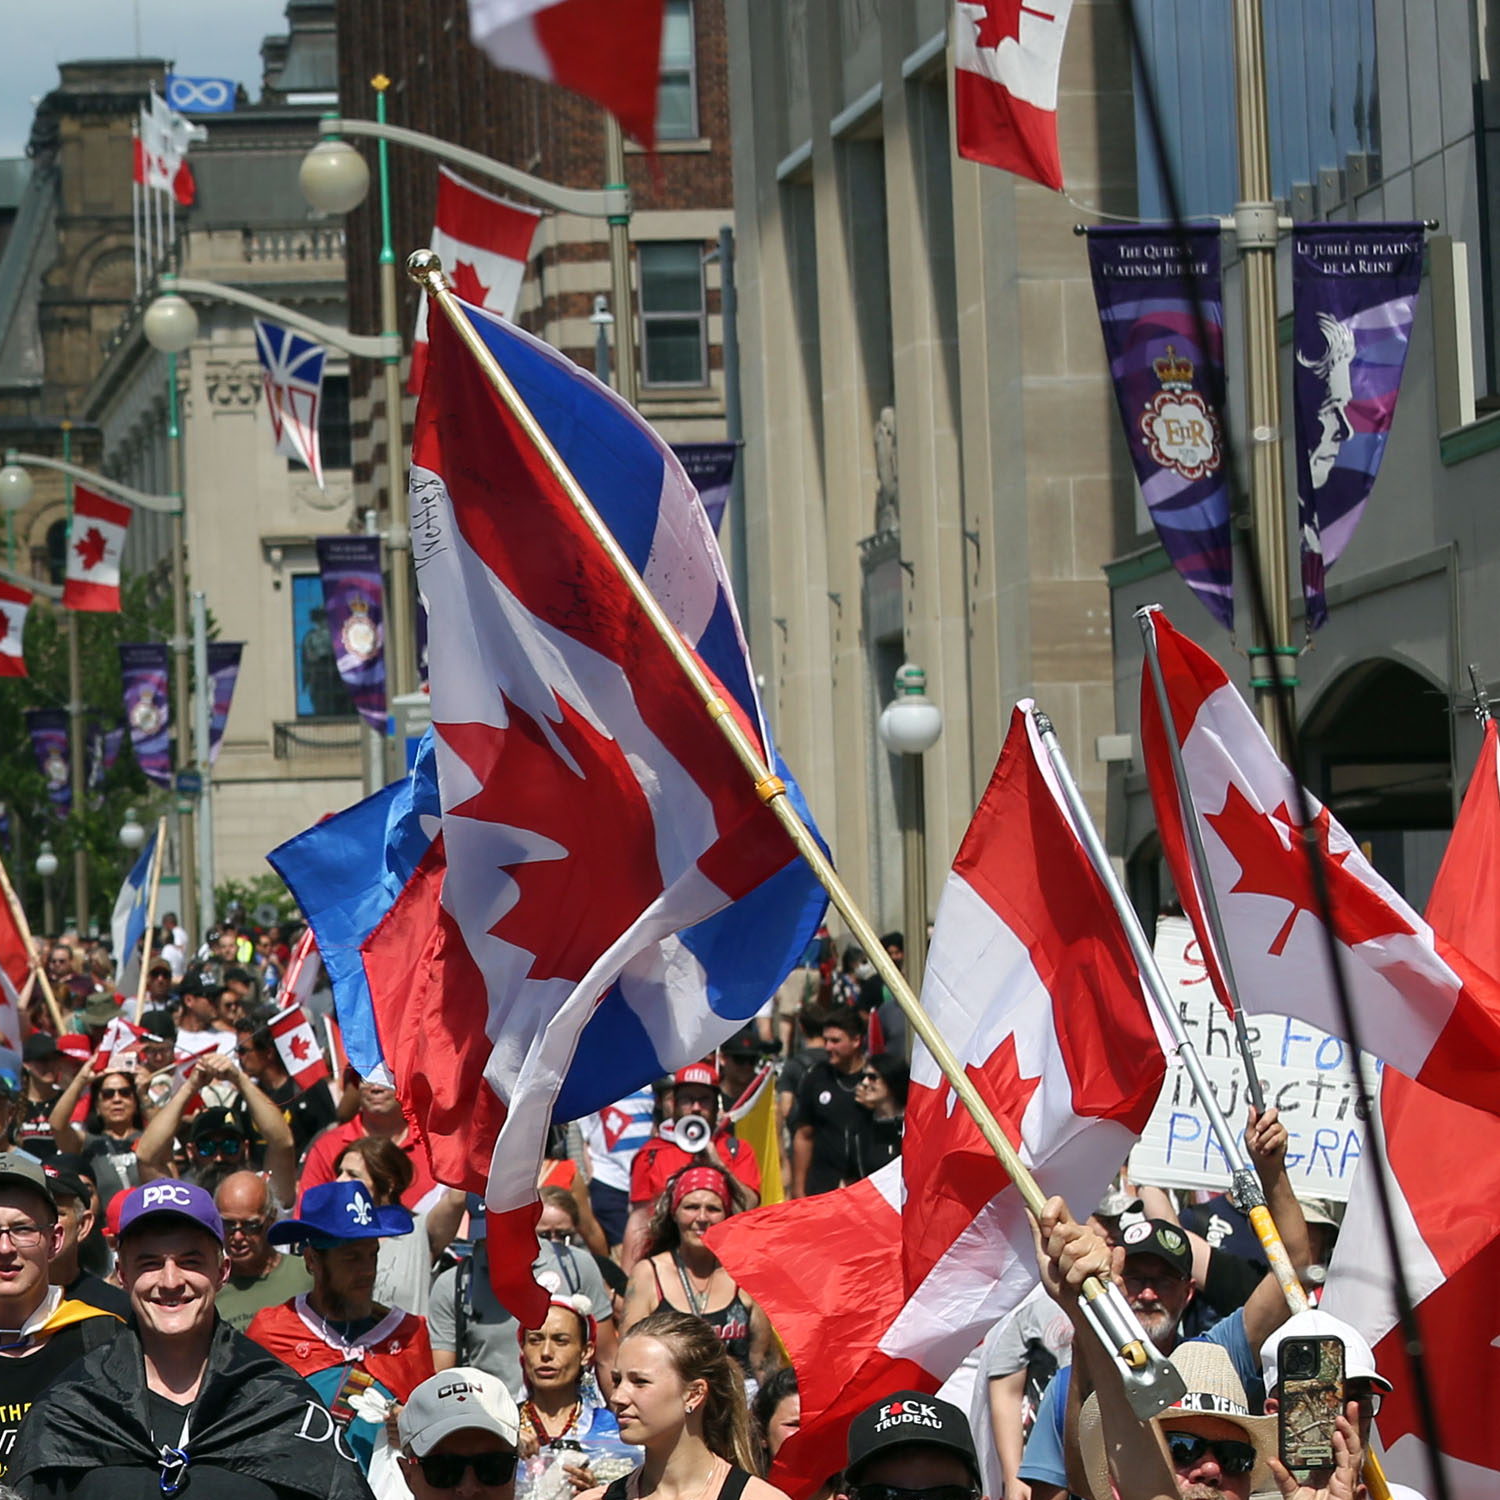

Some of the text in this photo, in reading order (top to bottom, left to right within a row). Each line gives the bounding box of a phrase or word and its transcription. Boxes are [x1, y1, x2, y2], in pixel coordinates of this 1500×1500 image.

[142, 1184, 191, 1209] PPC
[438, 1382, 484, 1400] CDN
[879, 1400, 938, 1423] FCK
[874, 1414, 943, 1433] TRUDEAU
